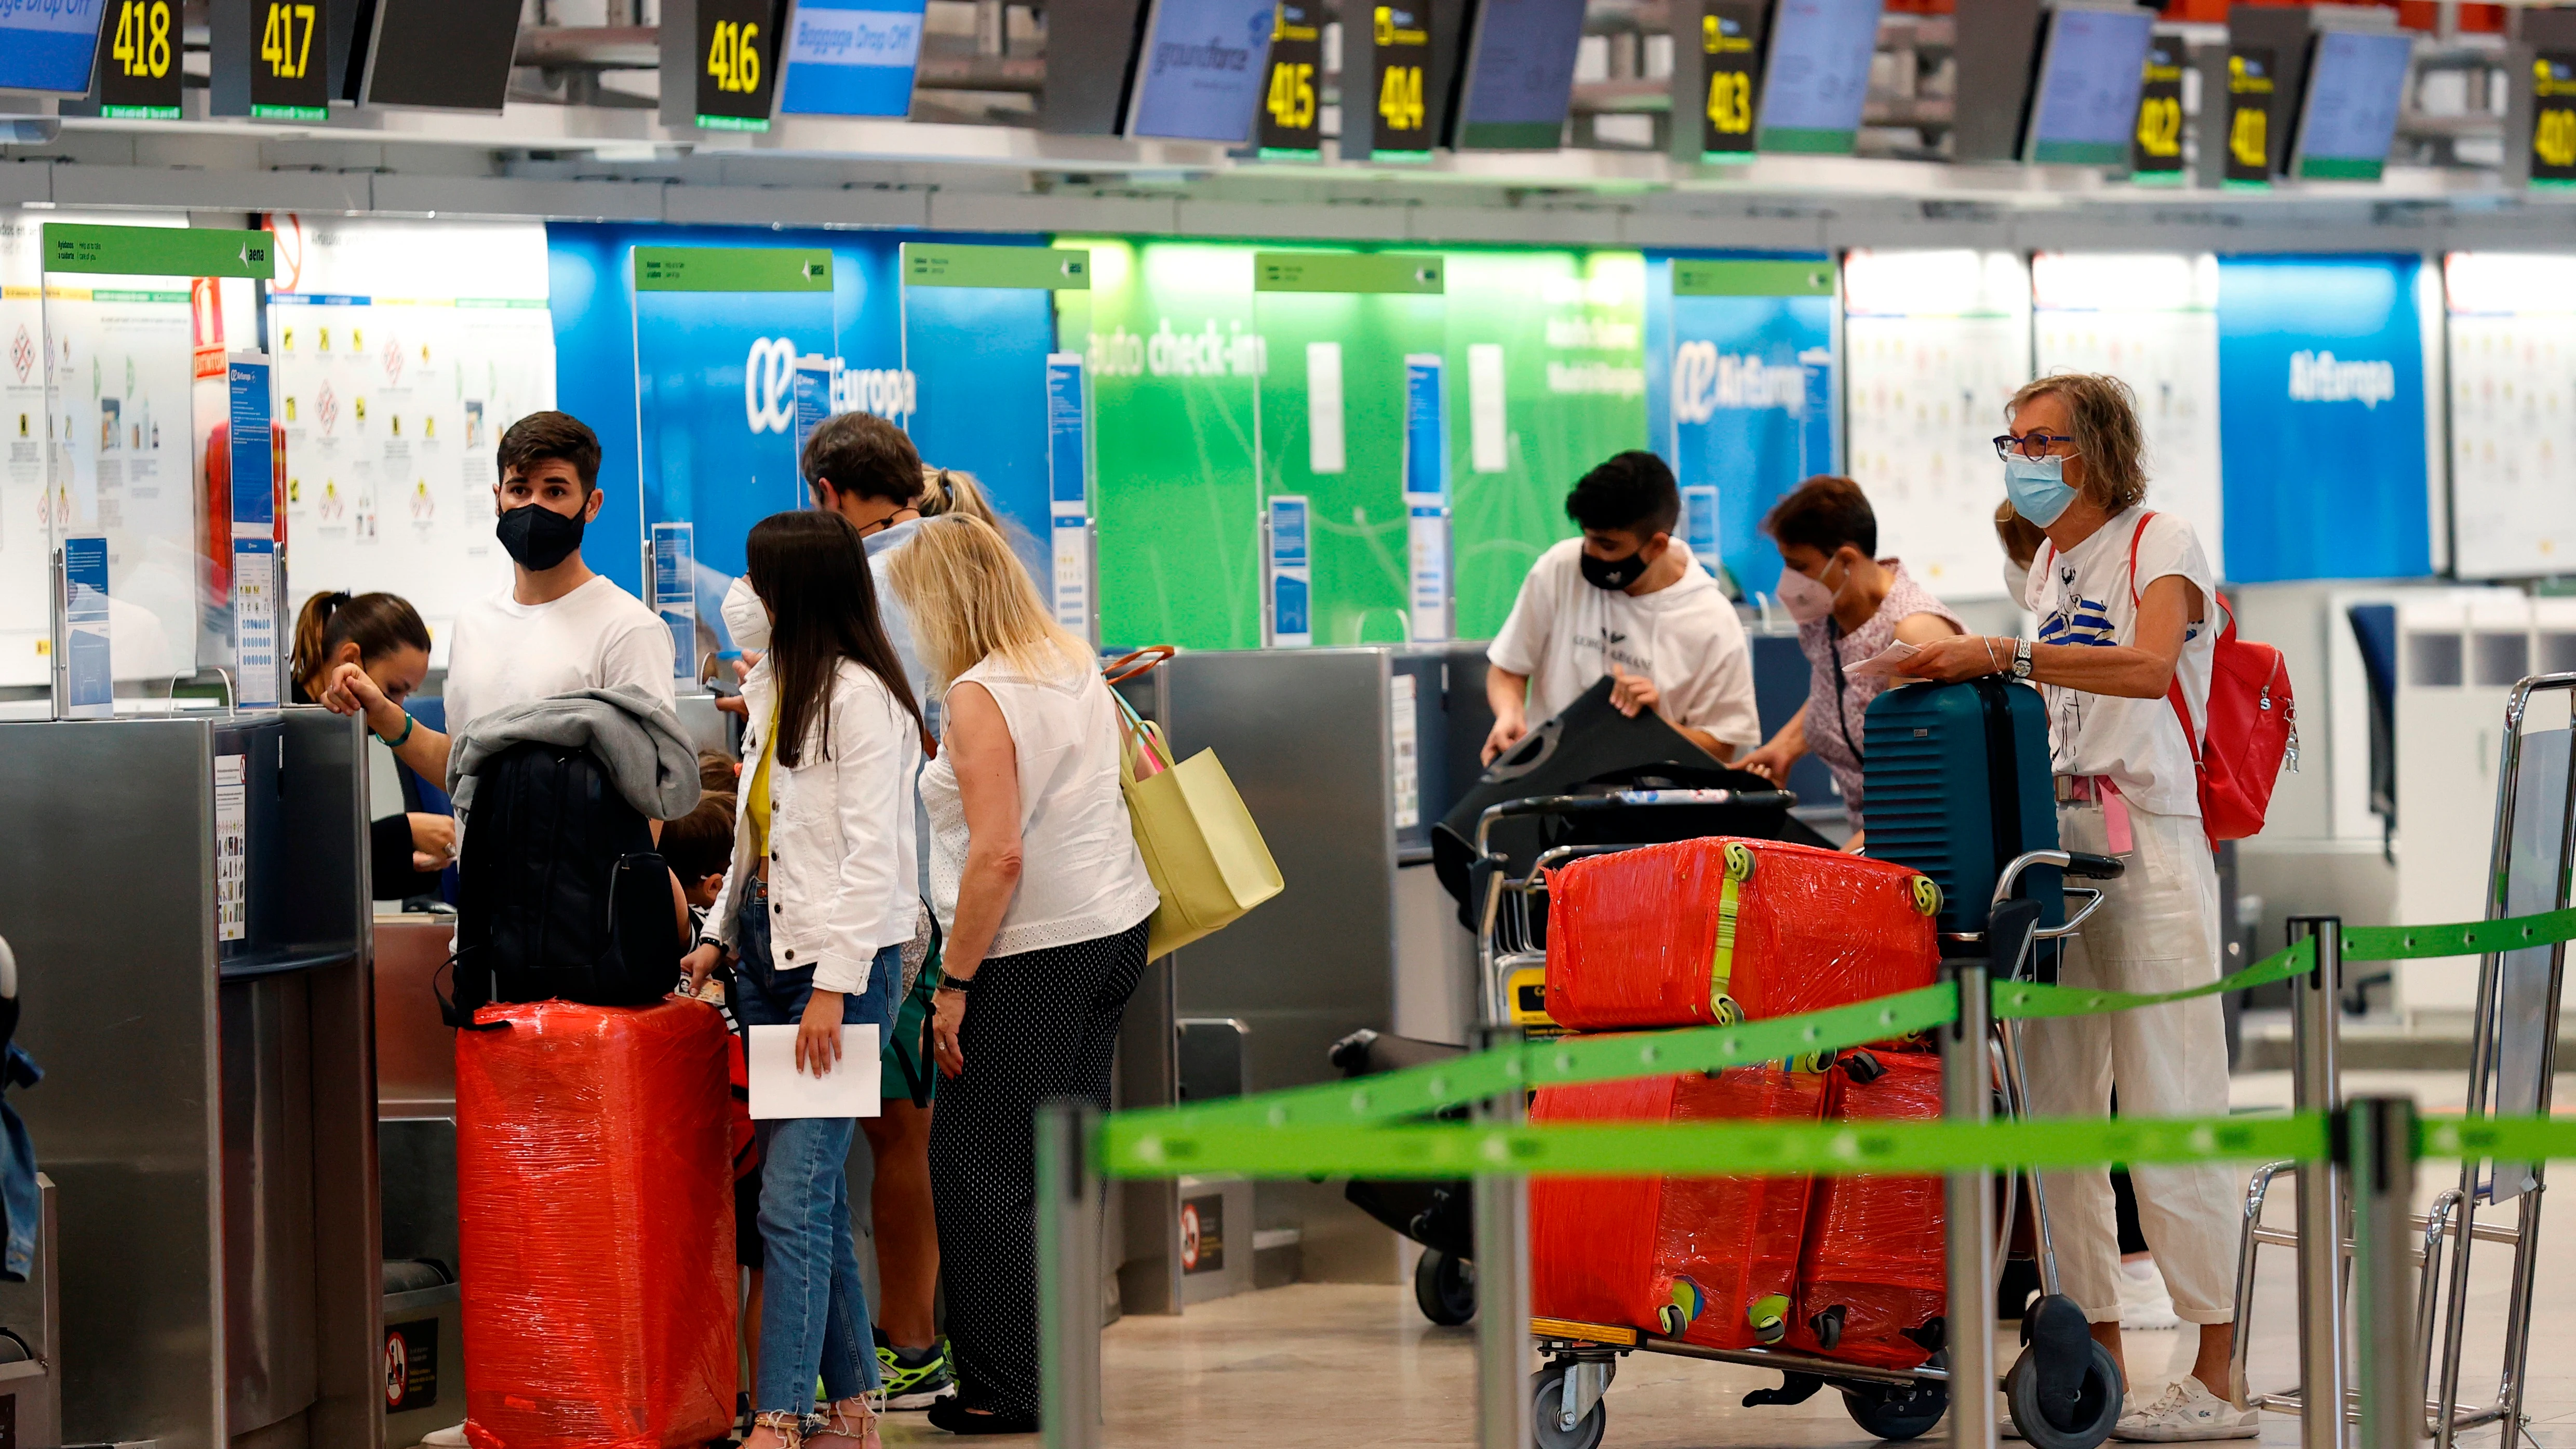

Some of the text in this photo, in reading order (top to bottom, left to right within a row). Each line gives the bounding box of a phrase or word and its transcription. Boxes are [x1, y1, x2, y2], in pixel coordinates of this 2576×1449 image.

[113, 0, 170, 78] 418
[261, 2, 316, 79] 417
[708, 20, 761, 93] 416
[1267, 62, 1316, 129] 415
[249, 249, 264, 261] aena
